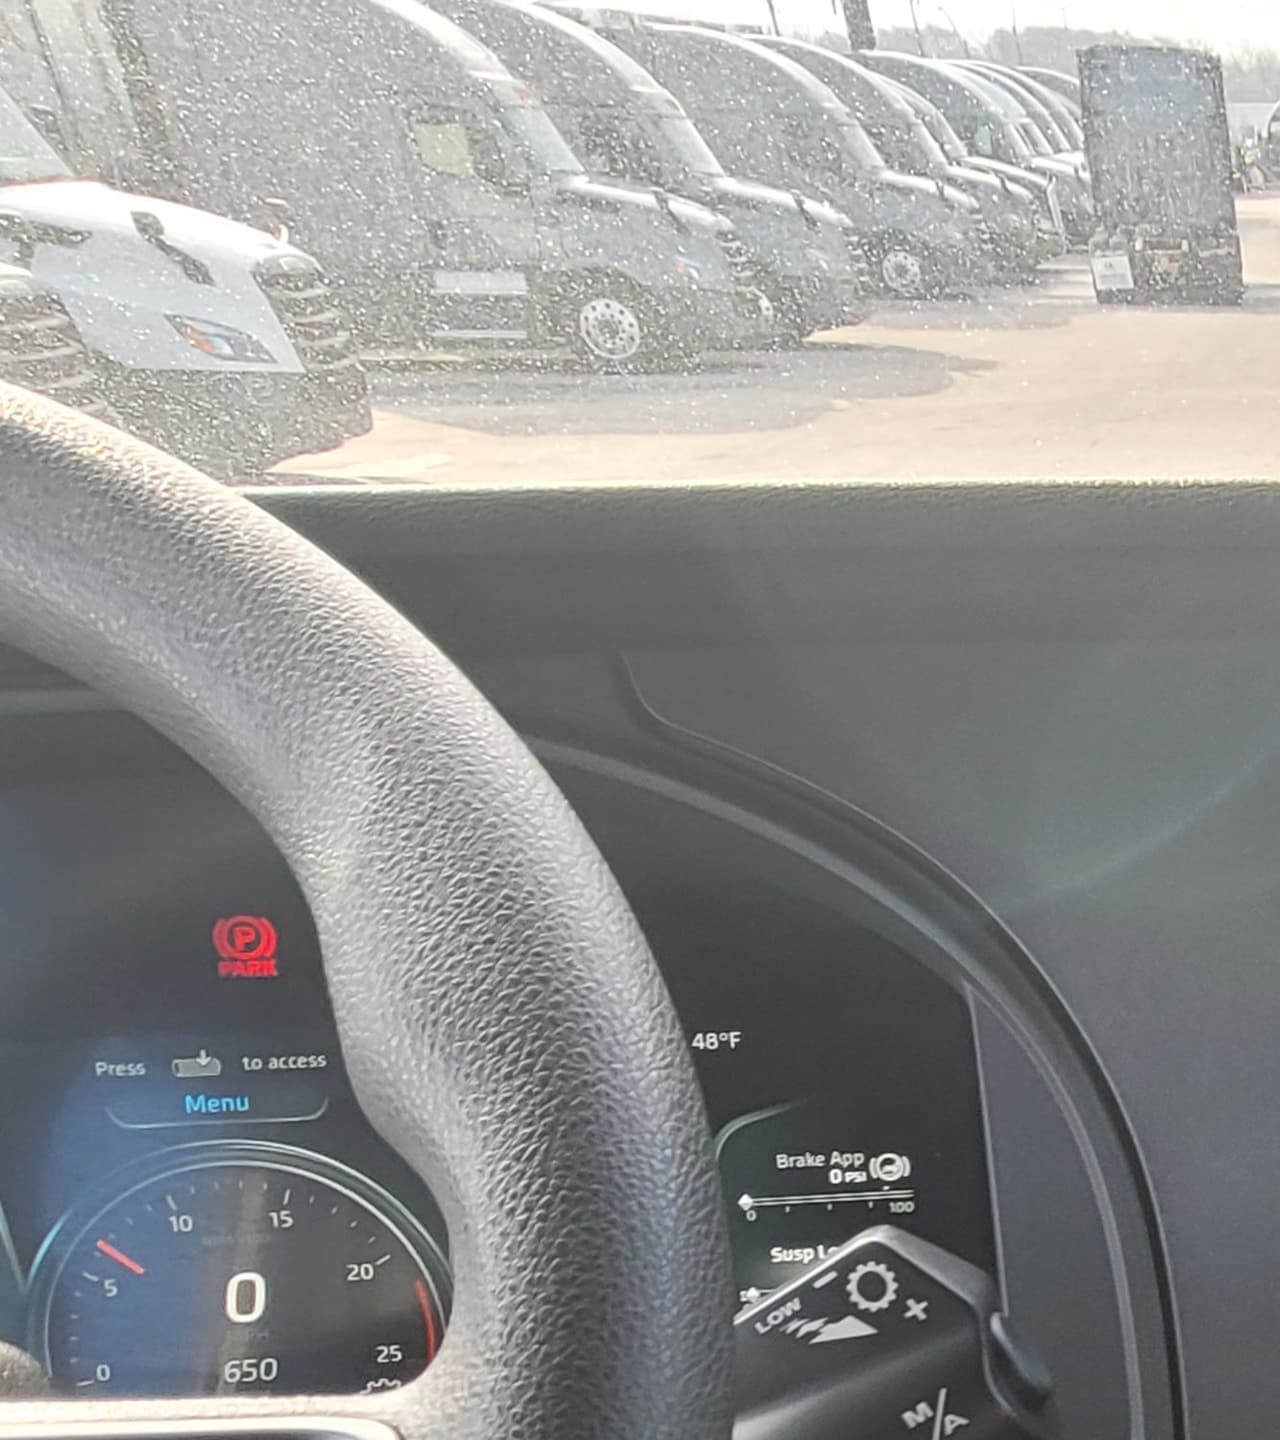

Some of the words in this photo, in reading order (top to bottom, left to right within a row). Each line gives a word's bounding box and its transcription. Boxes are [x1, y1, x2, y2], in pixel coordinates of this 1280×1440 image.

[691, 1031, 742, 1050] 48°F
[95, 1061, 147, 1077] Press
[242, 1056, 262, 1071] to
[268, 1055, 328, 1070] access
[185, 1094, 250, 1114] Menu
[775, 1152, 826, 1169] Brake
[829, 1151, 865, 1168] App
[829, 1168, 843, 1184] 0
[844, 1170, 868, 1184] PSI
[746, 1209, 757, 1221] 0
[889, 1201, 915, 1213] 100
[168, 1215, 193, 1233] 10
[269, 1210, 294, 1228] 15
[770, 1246, 816, 1264] Susp
[346, 1263, 374, 1281] 20
[104, 1278, 118, 1297] 5
[225, 1271, 266, 1323] 0
[754, 1297, 802, 1334] LOW
[376, 1345, 403, 1364] 25
[96, 1364, 111, 1381] 0
[224, 1358, 278, 1383] 650
